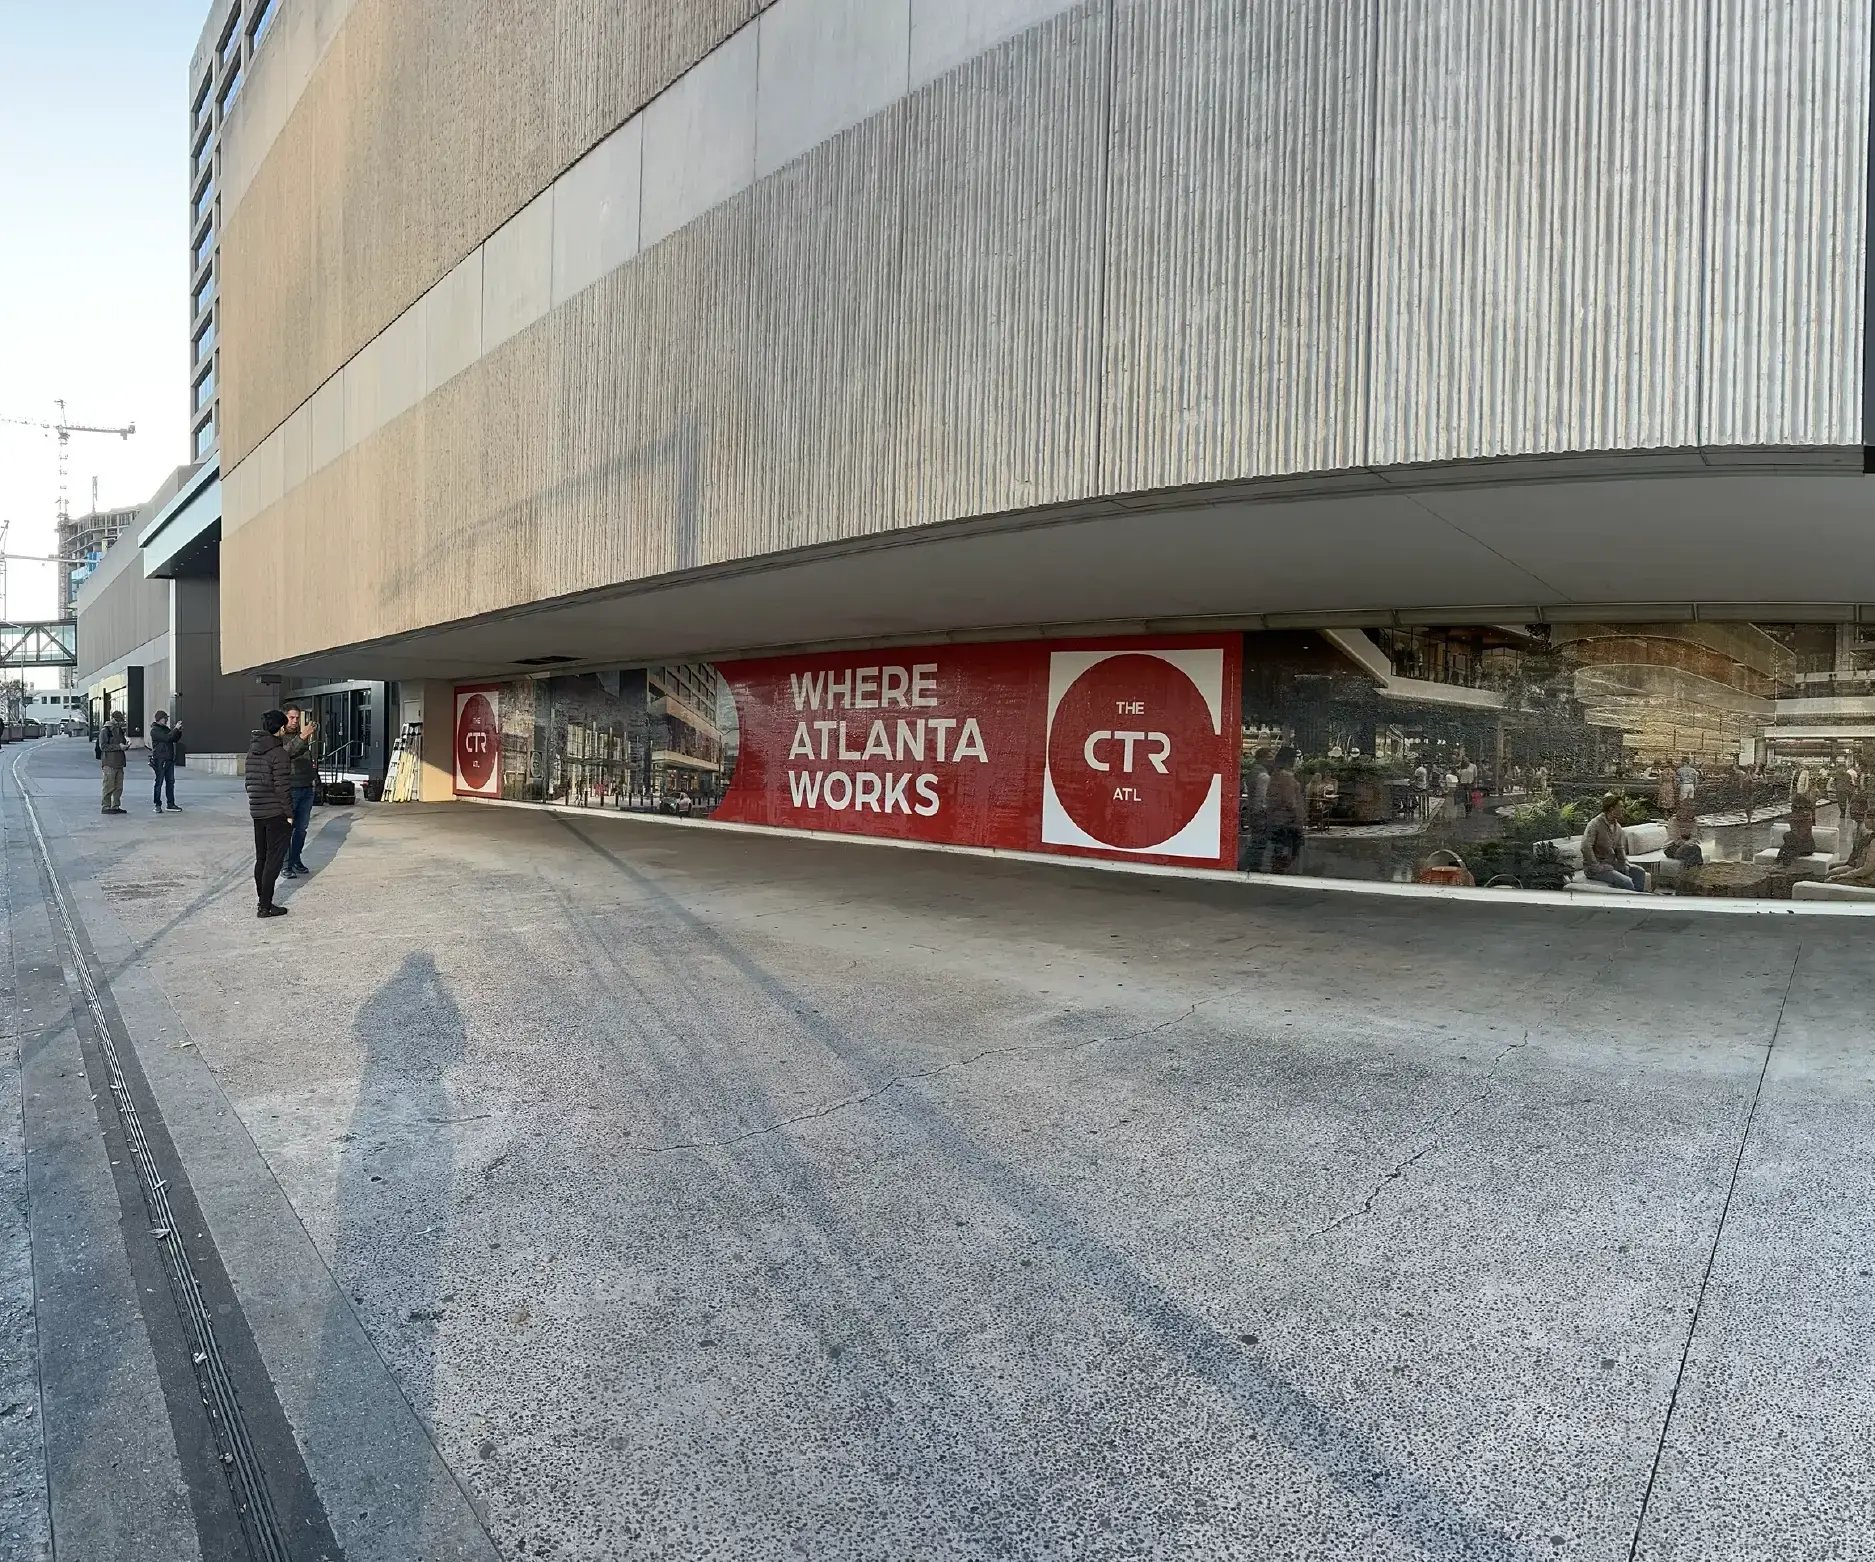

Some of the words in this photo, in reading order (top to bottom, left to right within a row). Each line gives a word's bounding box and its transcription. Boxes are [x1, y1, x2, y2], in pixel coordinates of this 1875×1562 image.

[790, 663, 938, 711] WHERE
[1116, 701, 1145, 715] THE
[465, 732, 487, 753] CTR
[788, 717, 989, 763] ATLANTA
[1084, 730, 1171, 774] CTR
[788, 770, 940, 817] WORKS
[1112, 787, 1142, 802] ATL
